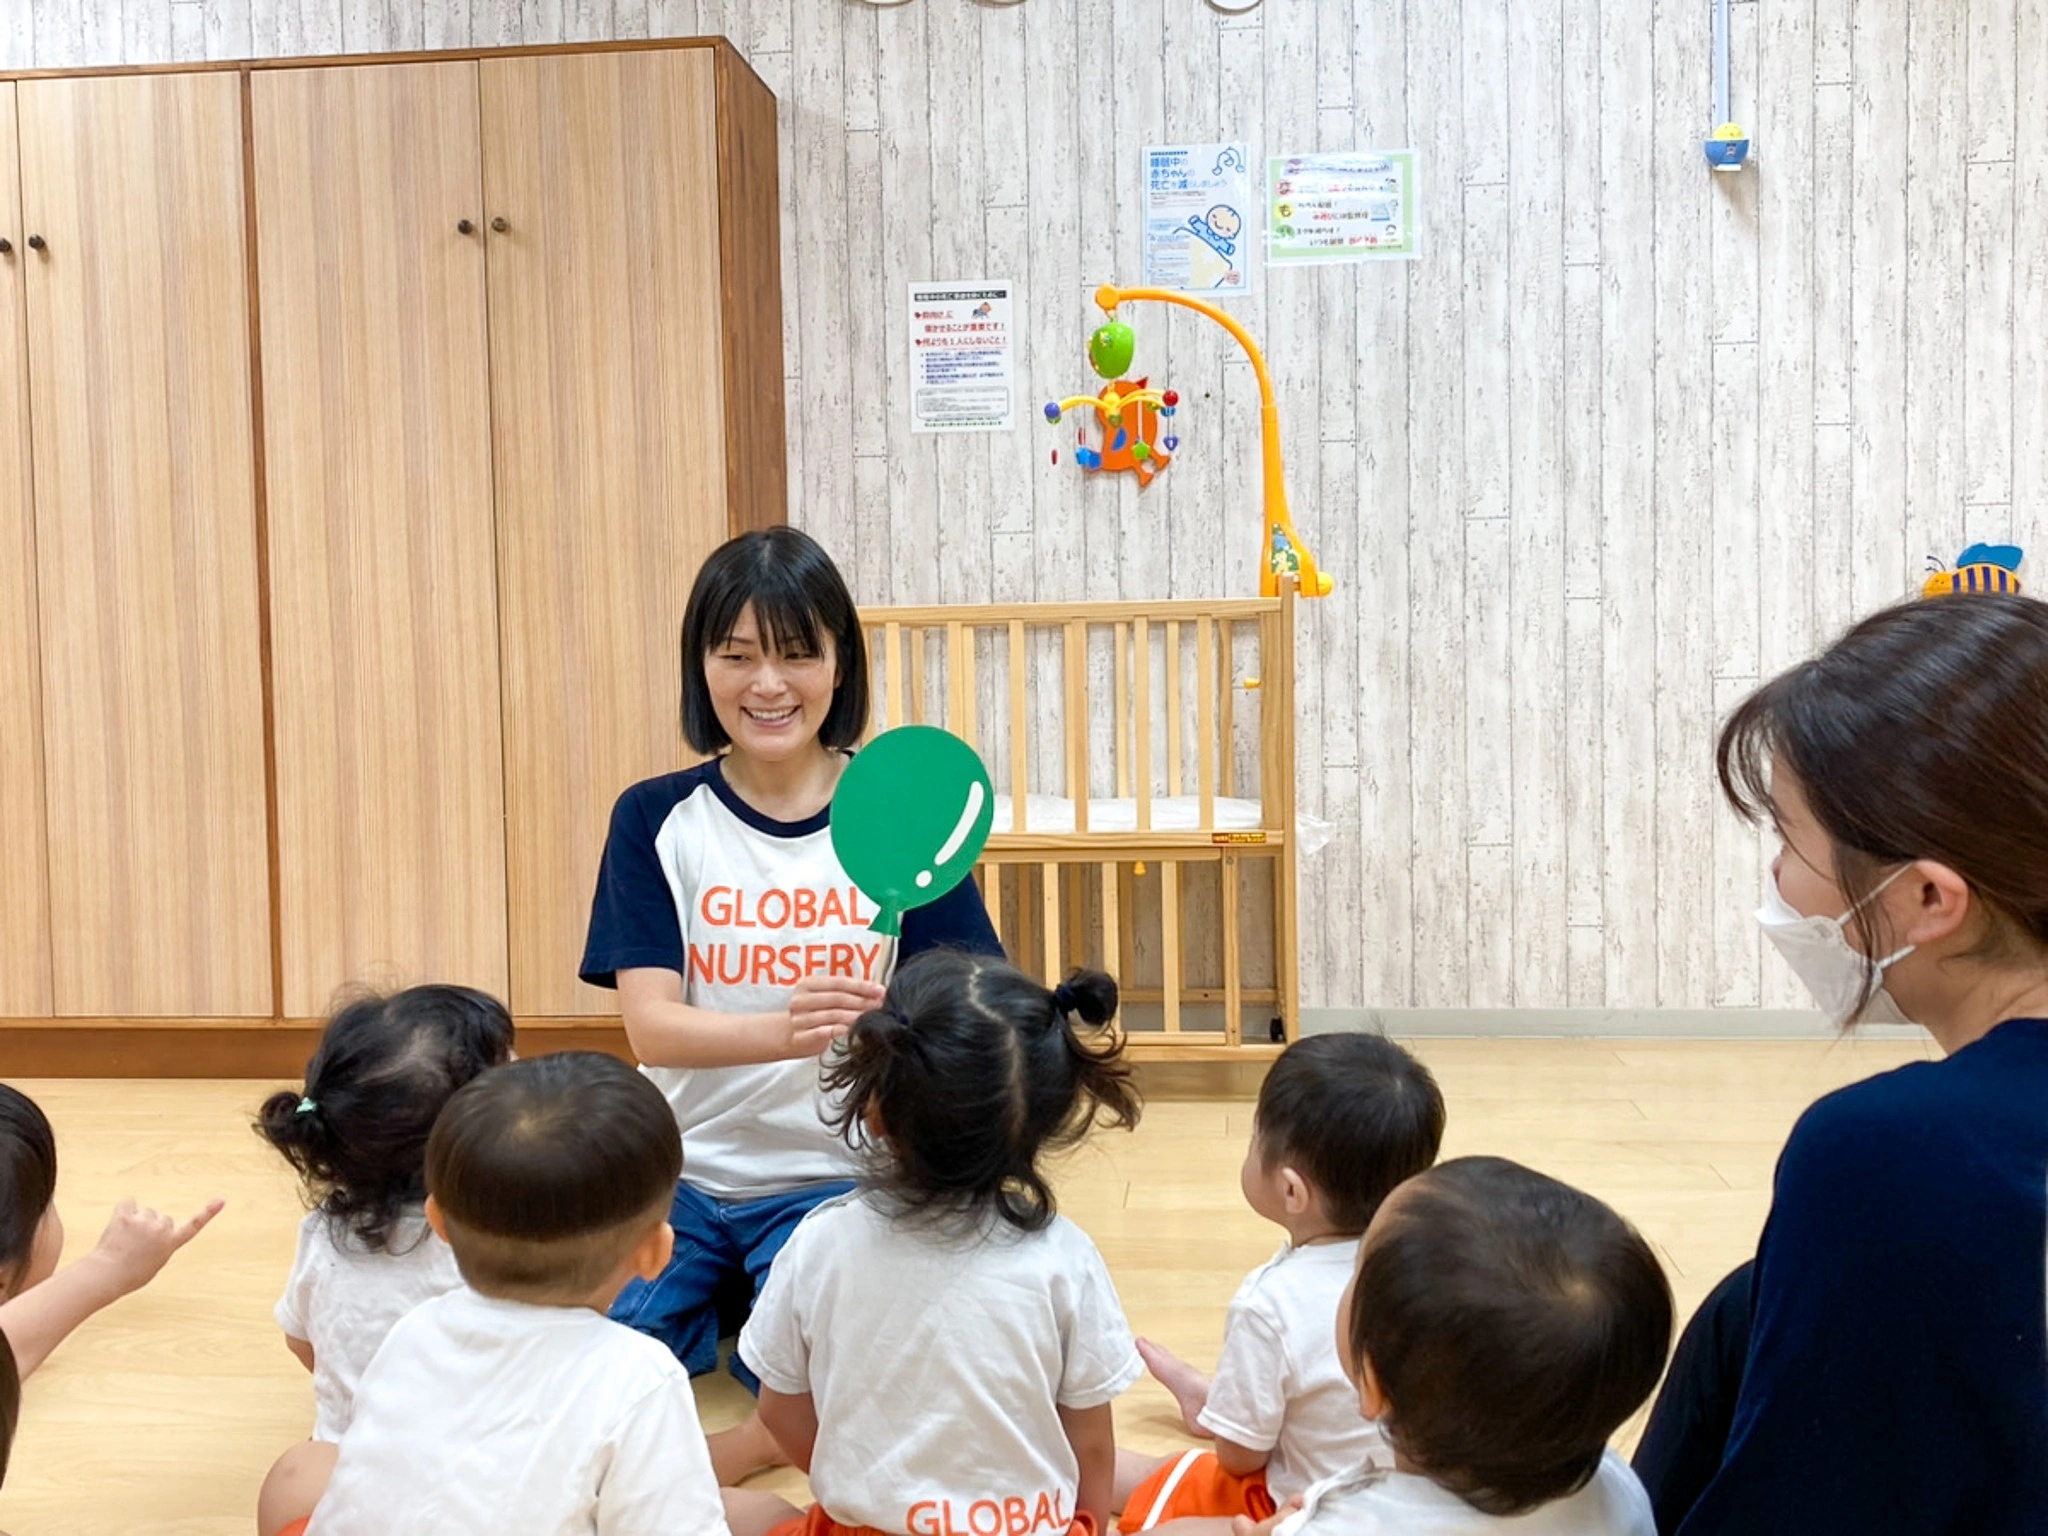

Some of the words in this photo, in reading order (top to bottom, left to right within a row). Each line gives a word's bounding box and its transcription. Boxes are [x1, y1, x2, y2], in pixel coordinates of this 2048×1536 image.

[702, 885, 870, 929] GLOBAL
[689, 943, 881, 986] NURSERY
[906, 1488, 1071, 1536] GLOBAL
